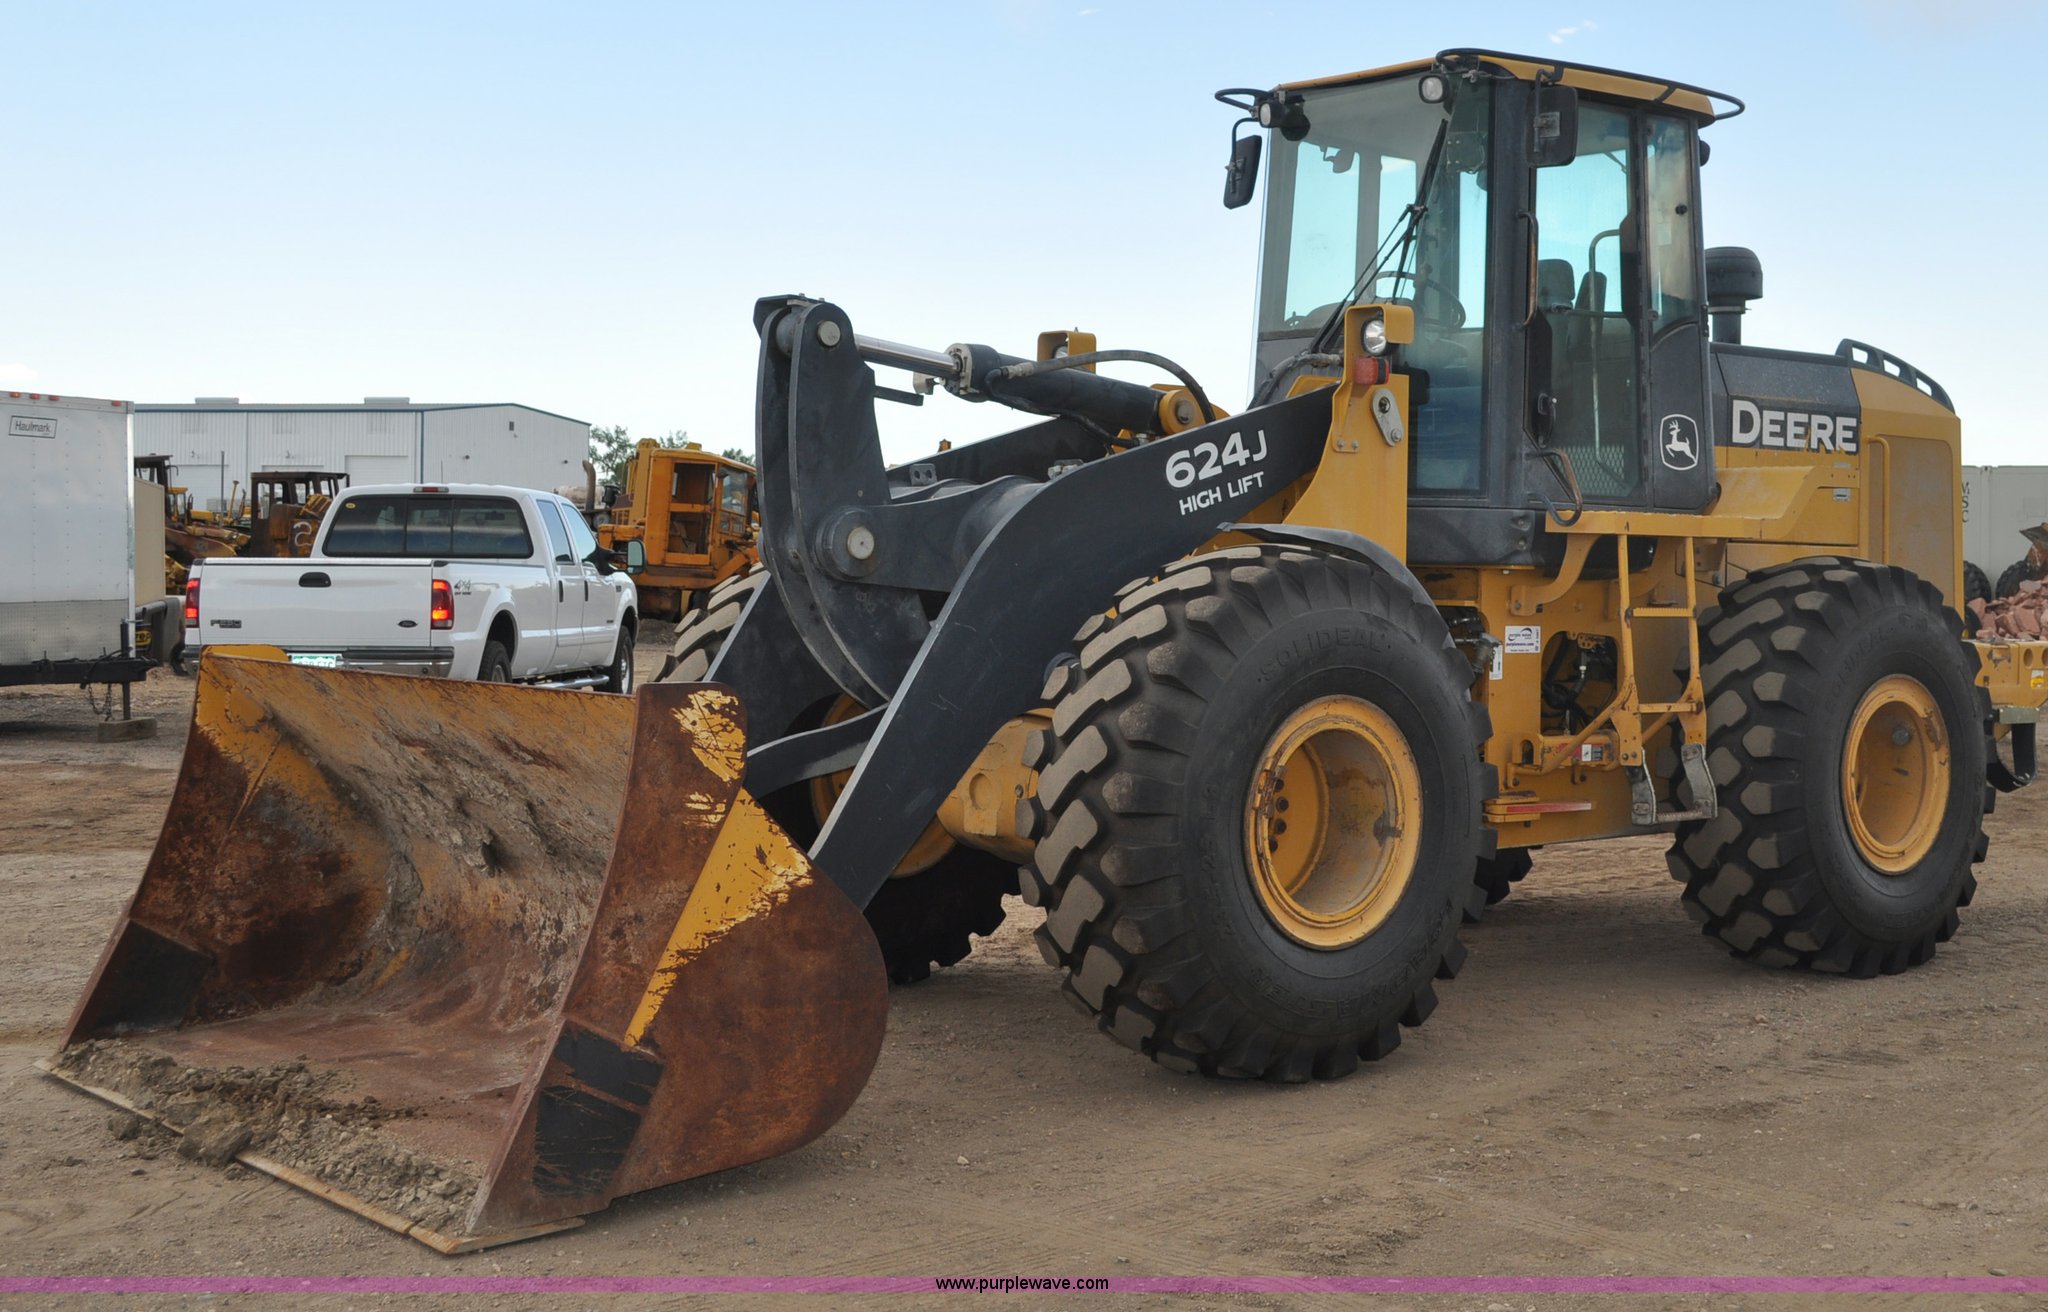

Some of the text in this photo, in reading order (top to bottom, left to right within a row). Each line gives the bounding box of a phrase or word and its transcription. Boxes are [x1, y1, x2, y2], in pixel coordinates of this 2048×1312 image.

[15, 420, 52, 433] Haulmark
[1732, 399, 1857, 452] DEERE
[1165, 429, 1268, 489] 624J
[1178, 471, 1265, 516] HIGH LIFT
